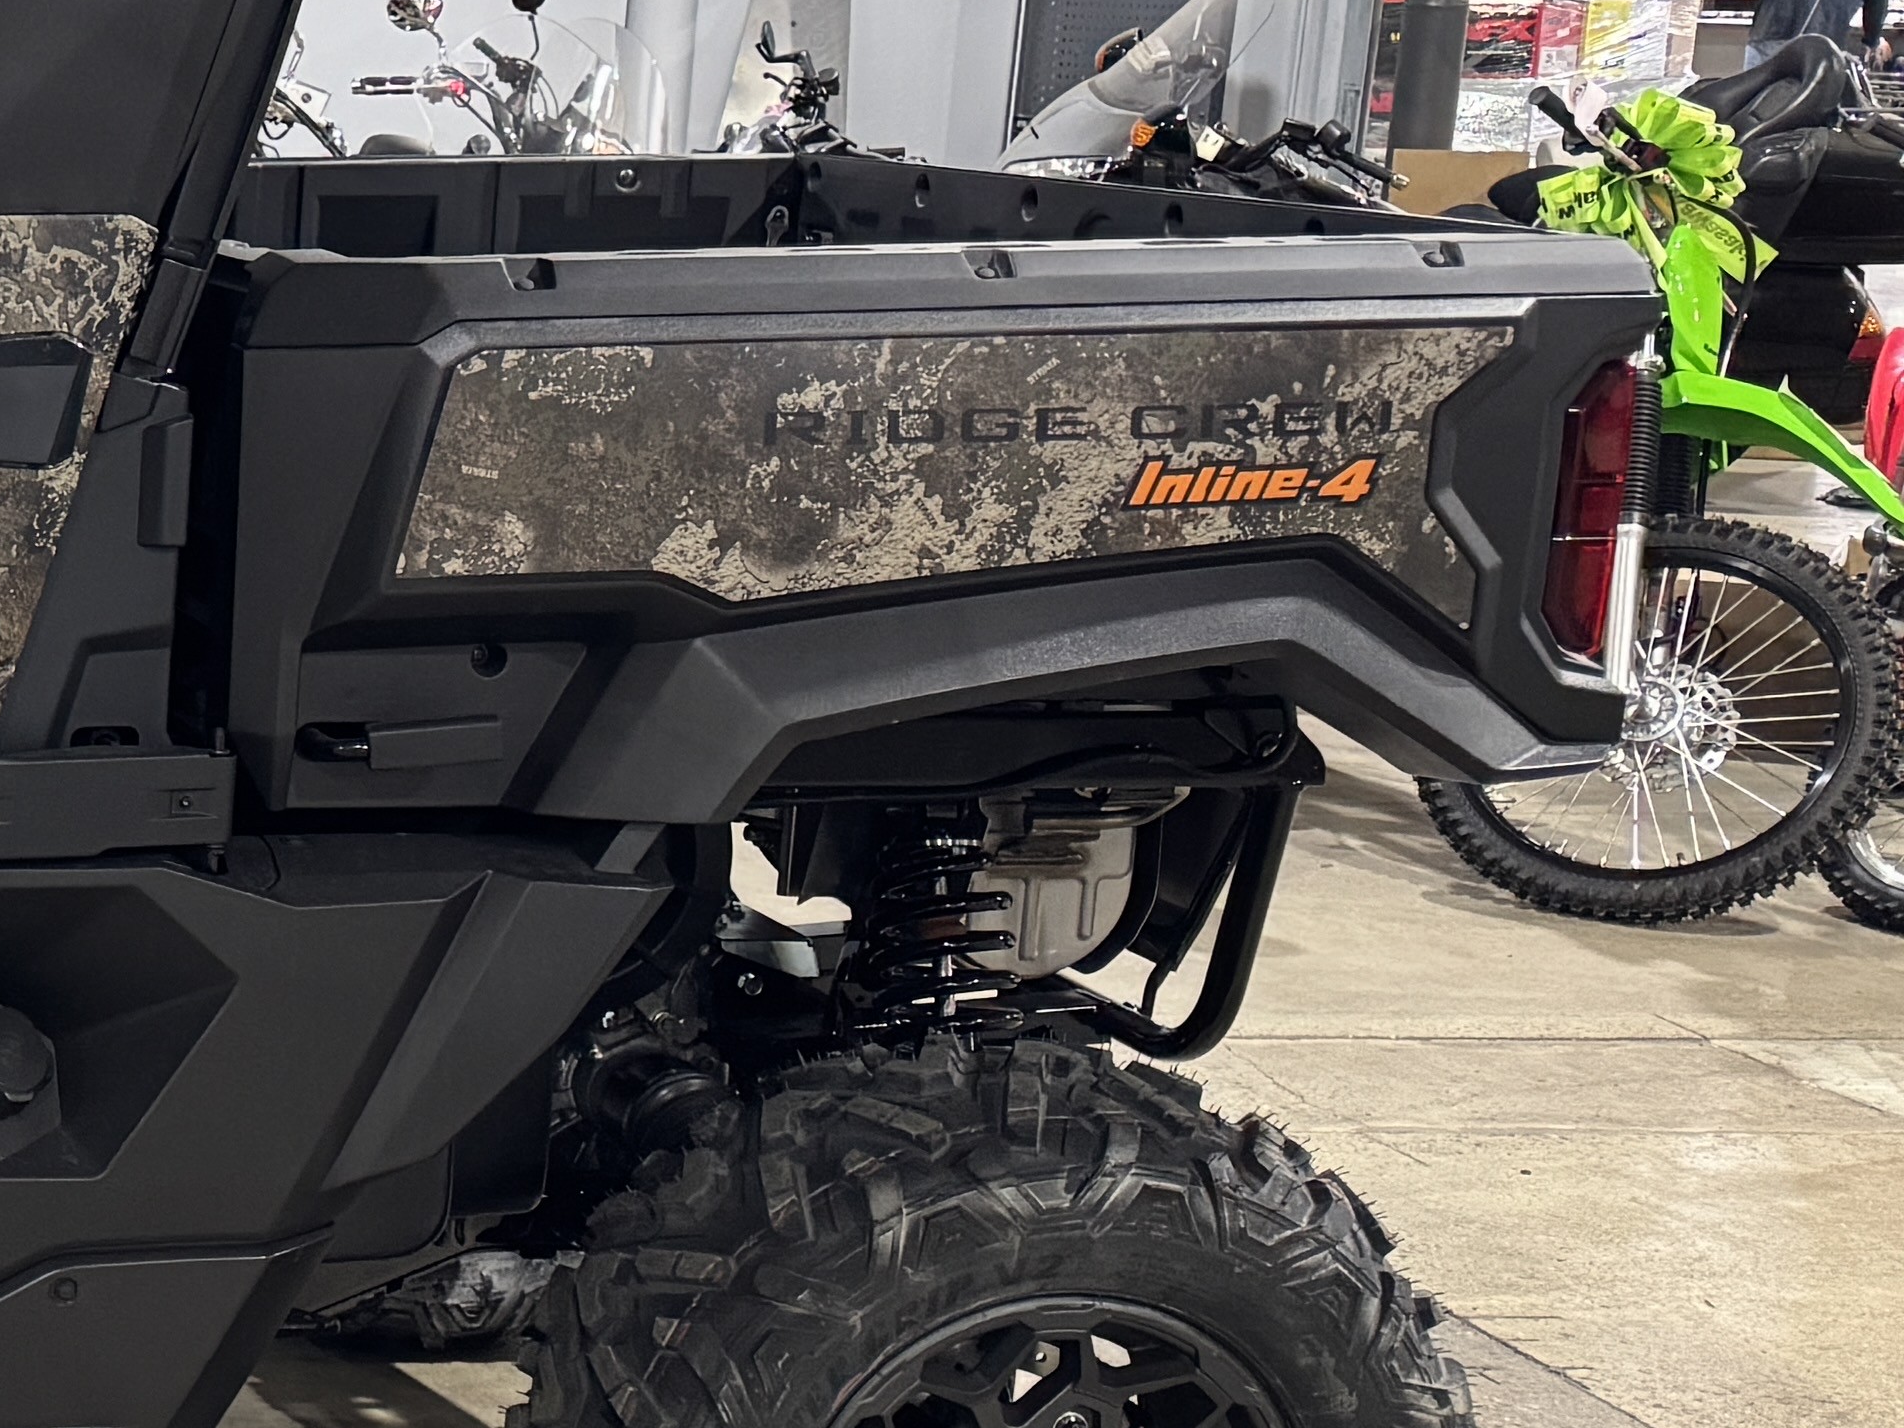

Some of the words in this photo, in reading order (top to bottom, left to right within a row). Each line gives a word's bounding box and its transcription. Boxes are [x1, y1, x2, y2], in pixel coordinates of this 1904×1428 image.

[1026, 357, 1060, 384] STRATA
[762, 406, 1092, 447] RIDGE
[1130, 400, 1394, 442] CREW
[1128, 458, 1379, 507] Inline-4
